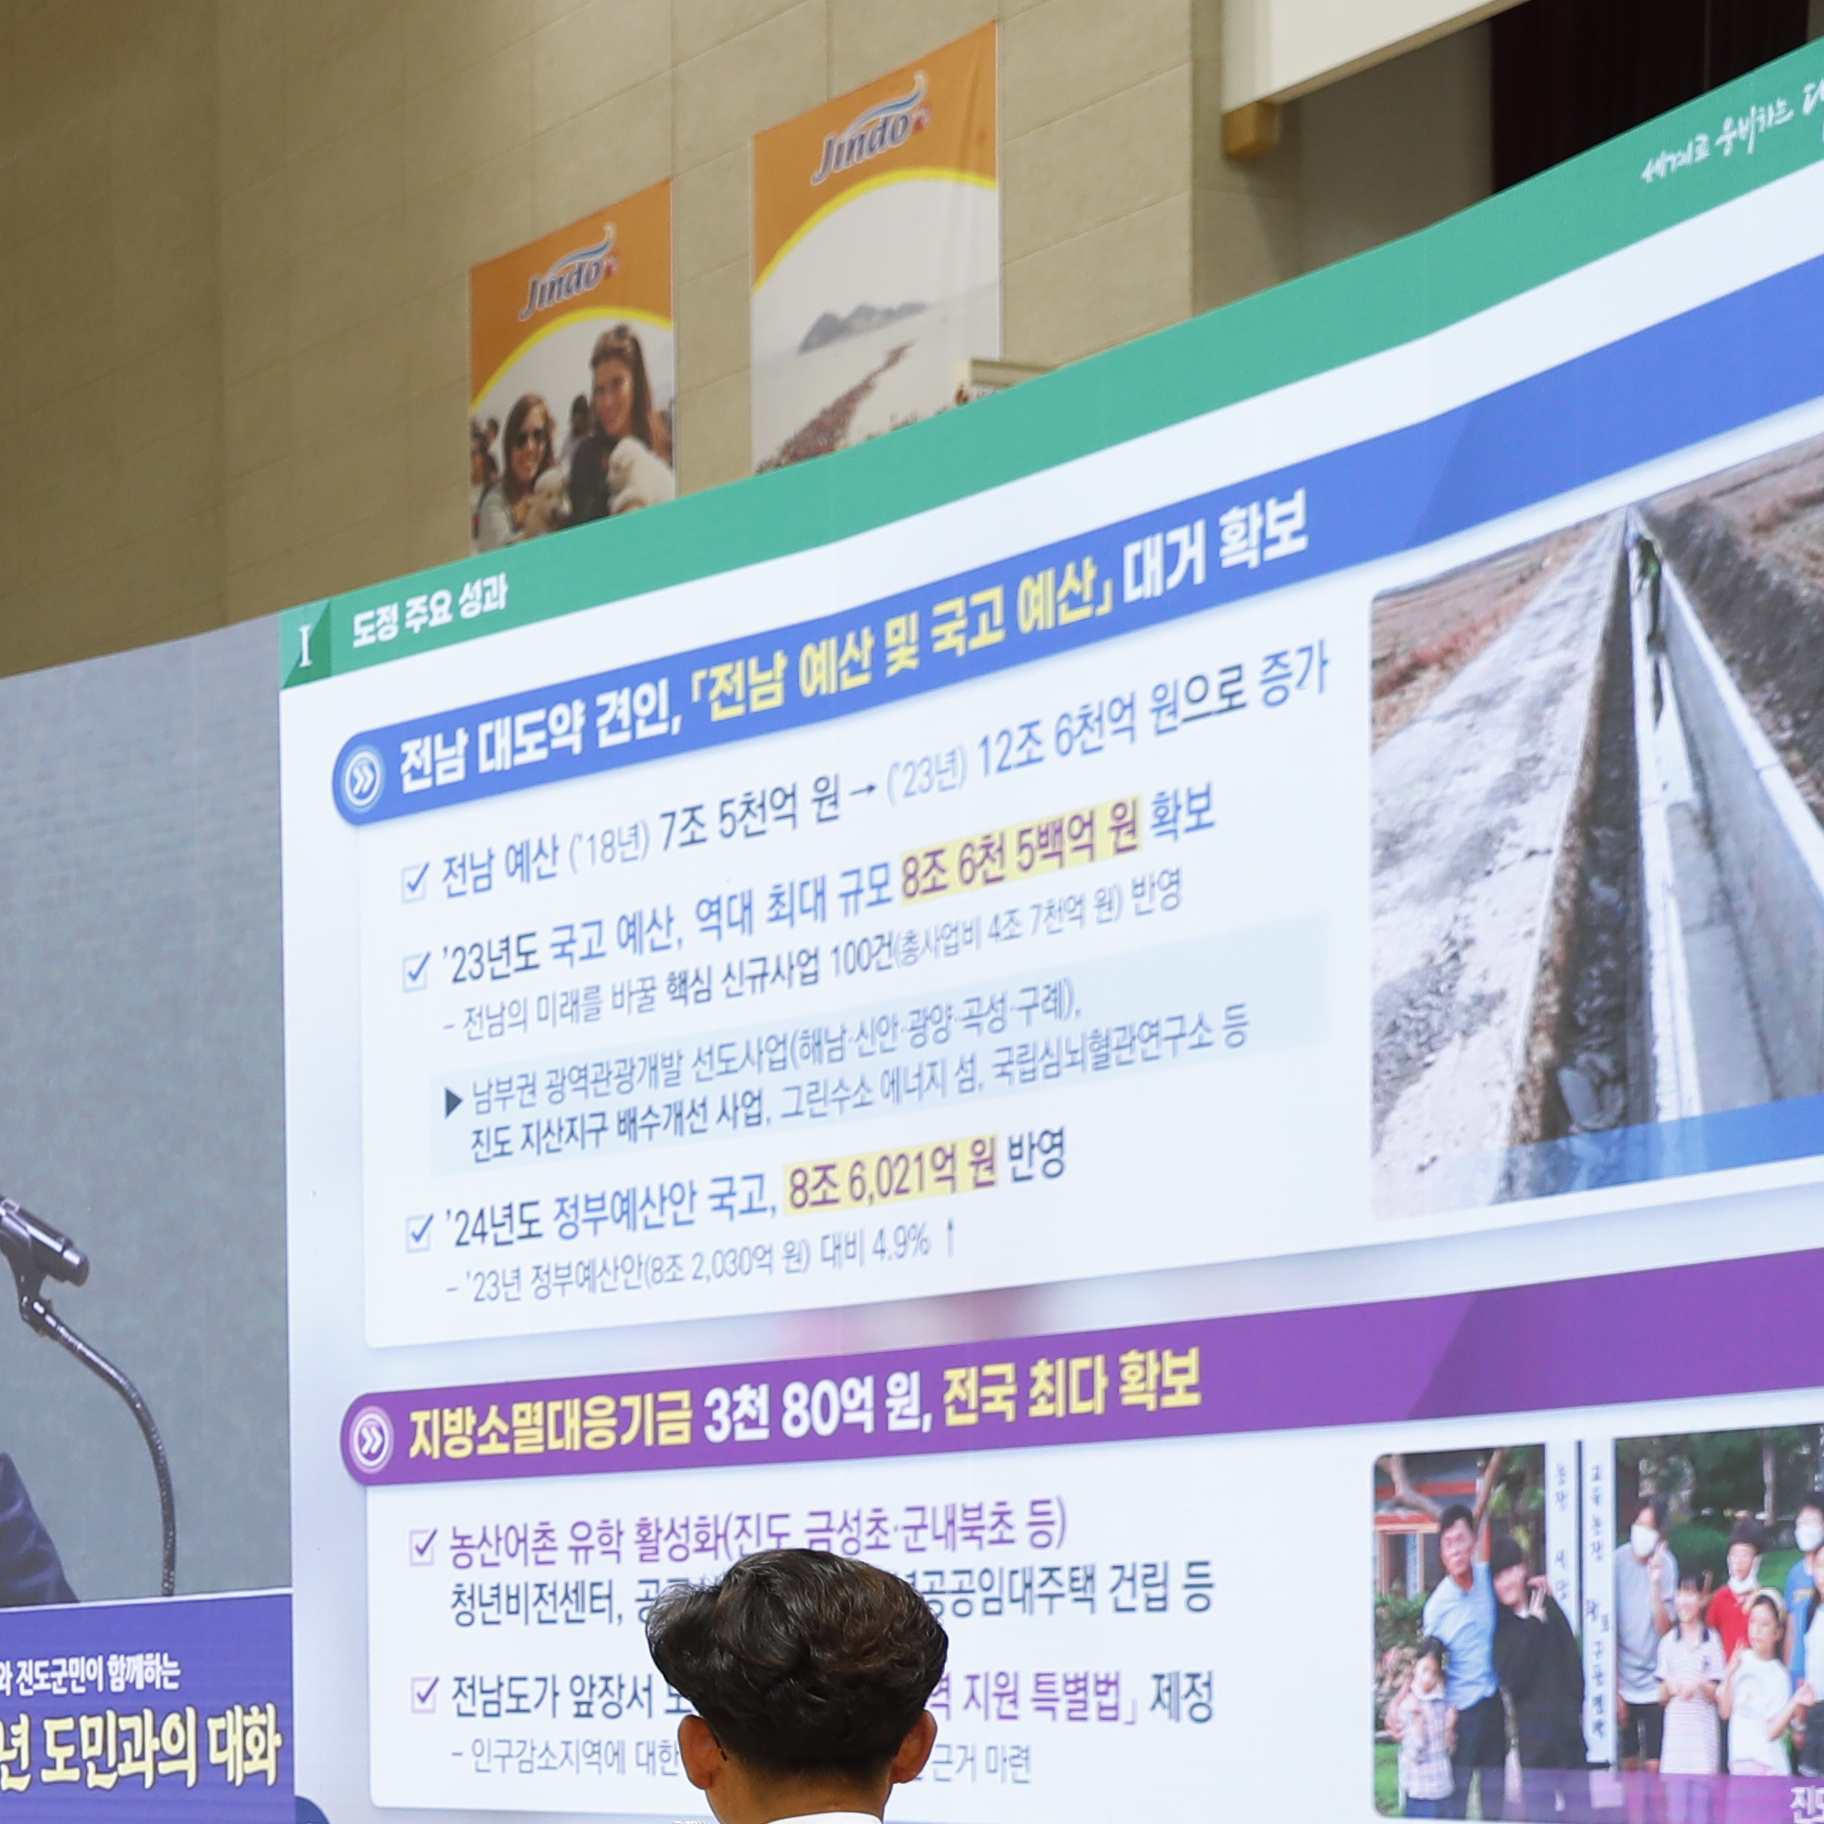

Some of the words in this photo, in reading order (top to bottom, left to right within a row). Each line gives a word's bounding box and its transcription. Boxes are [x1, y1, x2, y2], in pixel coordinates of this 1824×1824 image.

[811, 112, 913, 185] Jindo
[519, 258, 604, 322] Jindo
[353, 603, 398, 647] 도정
[405, 587, 453, 634] 주요
[458, 572, 508, 617] 성과
[401, 738, 464, 793] 전남
[479, 709, 584, 776] 대도약
[596, 683, 680, 748] 견인,
[799, 634, 872, 694] 예산
[884, 611, 919, 668] 및
[932, 593, 1004, 662] 국고
[1125, 535, 1204, 602] 대거
[1219, 488, 1307, 569] 확보
[443, 852, 494, 899] 전남
[505, 836, 558, 884] 예산
[659, 806, 705, 850] 7조
[719, 791, 796, 839] 5천억
[811, 774, 840, 820] 원
[979, 718, 1044, 778] 12조
[1055, 690, 1135, 759] 6천억
[1150, 662, 1247, 731] 원으로
[1259, 639, 1328, 708] 증가
[442, 931, 540, 986] '23년도
[550, 920, 605, 969] 국고
[616, 903, 683, 959] 예산,
[695, 889, 753, 943] 역대
[766, 875, 826, 928] 최대
[838, 861, 892, 914] 규모
[902, 846, 948, 901] 8조
[959, 833, 1006, 887] 6천
[1016, 809, 1095, 873] 5백억
[1109, 799, 1138, 855] 원
[1151, 781, 1215, 841] 확보
[462, 995, 528, 1043] 전남의
[536, 982, 601, 1032] 미래를
[611, 975, 657, 1016] 바꿀
[666, 965, 713, 1006] 핵심
[722, 946, 820, 998] 신규사업
[988, 906, 1022, 945] 4조
[1030, 894, 1086, 936] 7천억
[1094, 882, 1123, 924] 원)
[1131, 867, 1183, 917] 반영
[470, 1125, 512, 1164] 진도
[520, 1111, 608, 1157] 지산지구
[617, 1096, 708, 1146] 배수개선
[716, 1088, 771, 1130] 사업,
[781, 1074, 873, 1123] 그린수소
[880, 1058, 947, 1103] 에너지
[955, 1054, 984, 1096] 섬,
[993, 1008, 1214, 1086] 국립심뇌혈관연구소
[1223, 1003, 1248, 1050] 등
[472, 1076, 537, 1115] 남부권
[545, 1047, 683, 1106] 광역관광개발
[445, 1201, 543, 1247] '24년도
[554, 1180, 698, 1240] 정부예산안
[707, 1174, 778, 1218] 국고,
[789, 1163, 839, 1210] 8조
[848, 1142, 957, 1206] 6,021억
[969, 1137, 997, 1187] 원
[1008, 1126, 1065, 1183] 반영
[692, 1241, 774, 1284] 2,030억
[783, 1237, 811, 1277] 원)
[821, 1227, 865, 1268] 대비
[873, 1219, 930, 1263] 4.9%
[409, 1388, 692, 1460] 지방소멸대응기금
[704, 1385, 771, 1443] 3천
[782, 1376, 875, 1438] 80억
[886, 1371, 932, 1435] 원,
[943, 1362, 1016, 1424] 전국
[1028, 1355, 1108, 1417] 최다
[1119, 1346, 1202, 1411] 확보
[449, 1516, 558, 1571] 농산어촌
[568, 1516, 624, 1566] 유학
[1027, 1495, 1067, 1549] 등)
[450, 1578, 625, 1628] 청년비전센터,
[1109, 1560, 1170, 1615] 건립
[1181, 1559, 1216, 1614] 등
[15, 1654, 104, 1696] 진도군민이
[106, 1651, 182, 1693] 함께하는
[450, 1672, 559, 1721] 전남도가
[569, 1671, 654, 1722] 앞장서
[962, 1670, 1021, 1722] 지원
[1148, 1668, 1216, 1725] 제정
[40, 1704, 198, 1790] 도민과의
[207, 1702, 283, 1787] 대화
[471, 1738, 626, 1778] 인구감소지역에
[931, 1742, 976, 1782] 근거
[985, 1743, 1033, 1785] 마련
